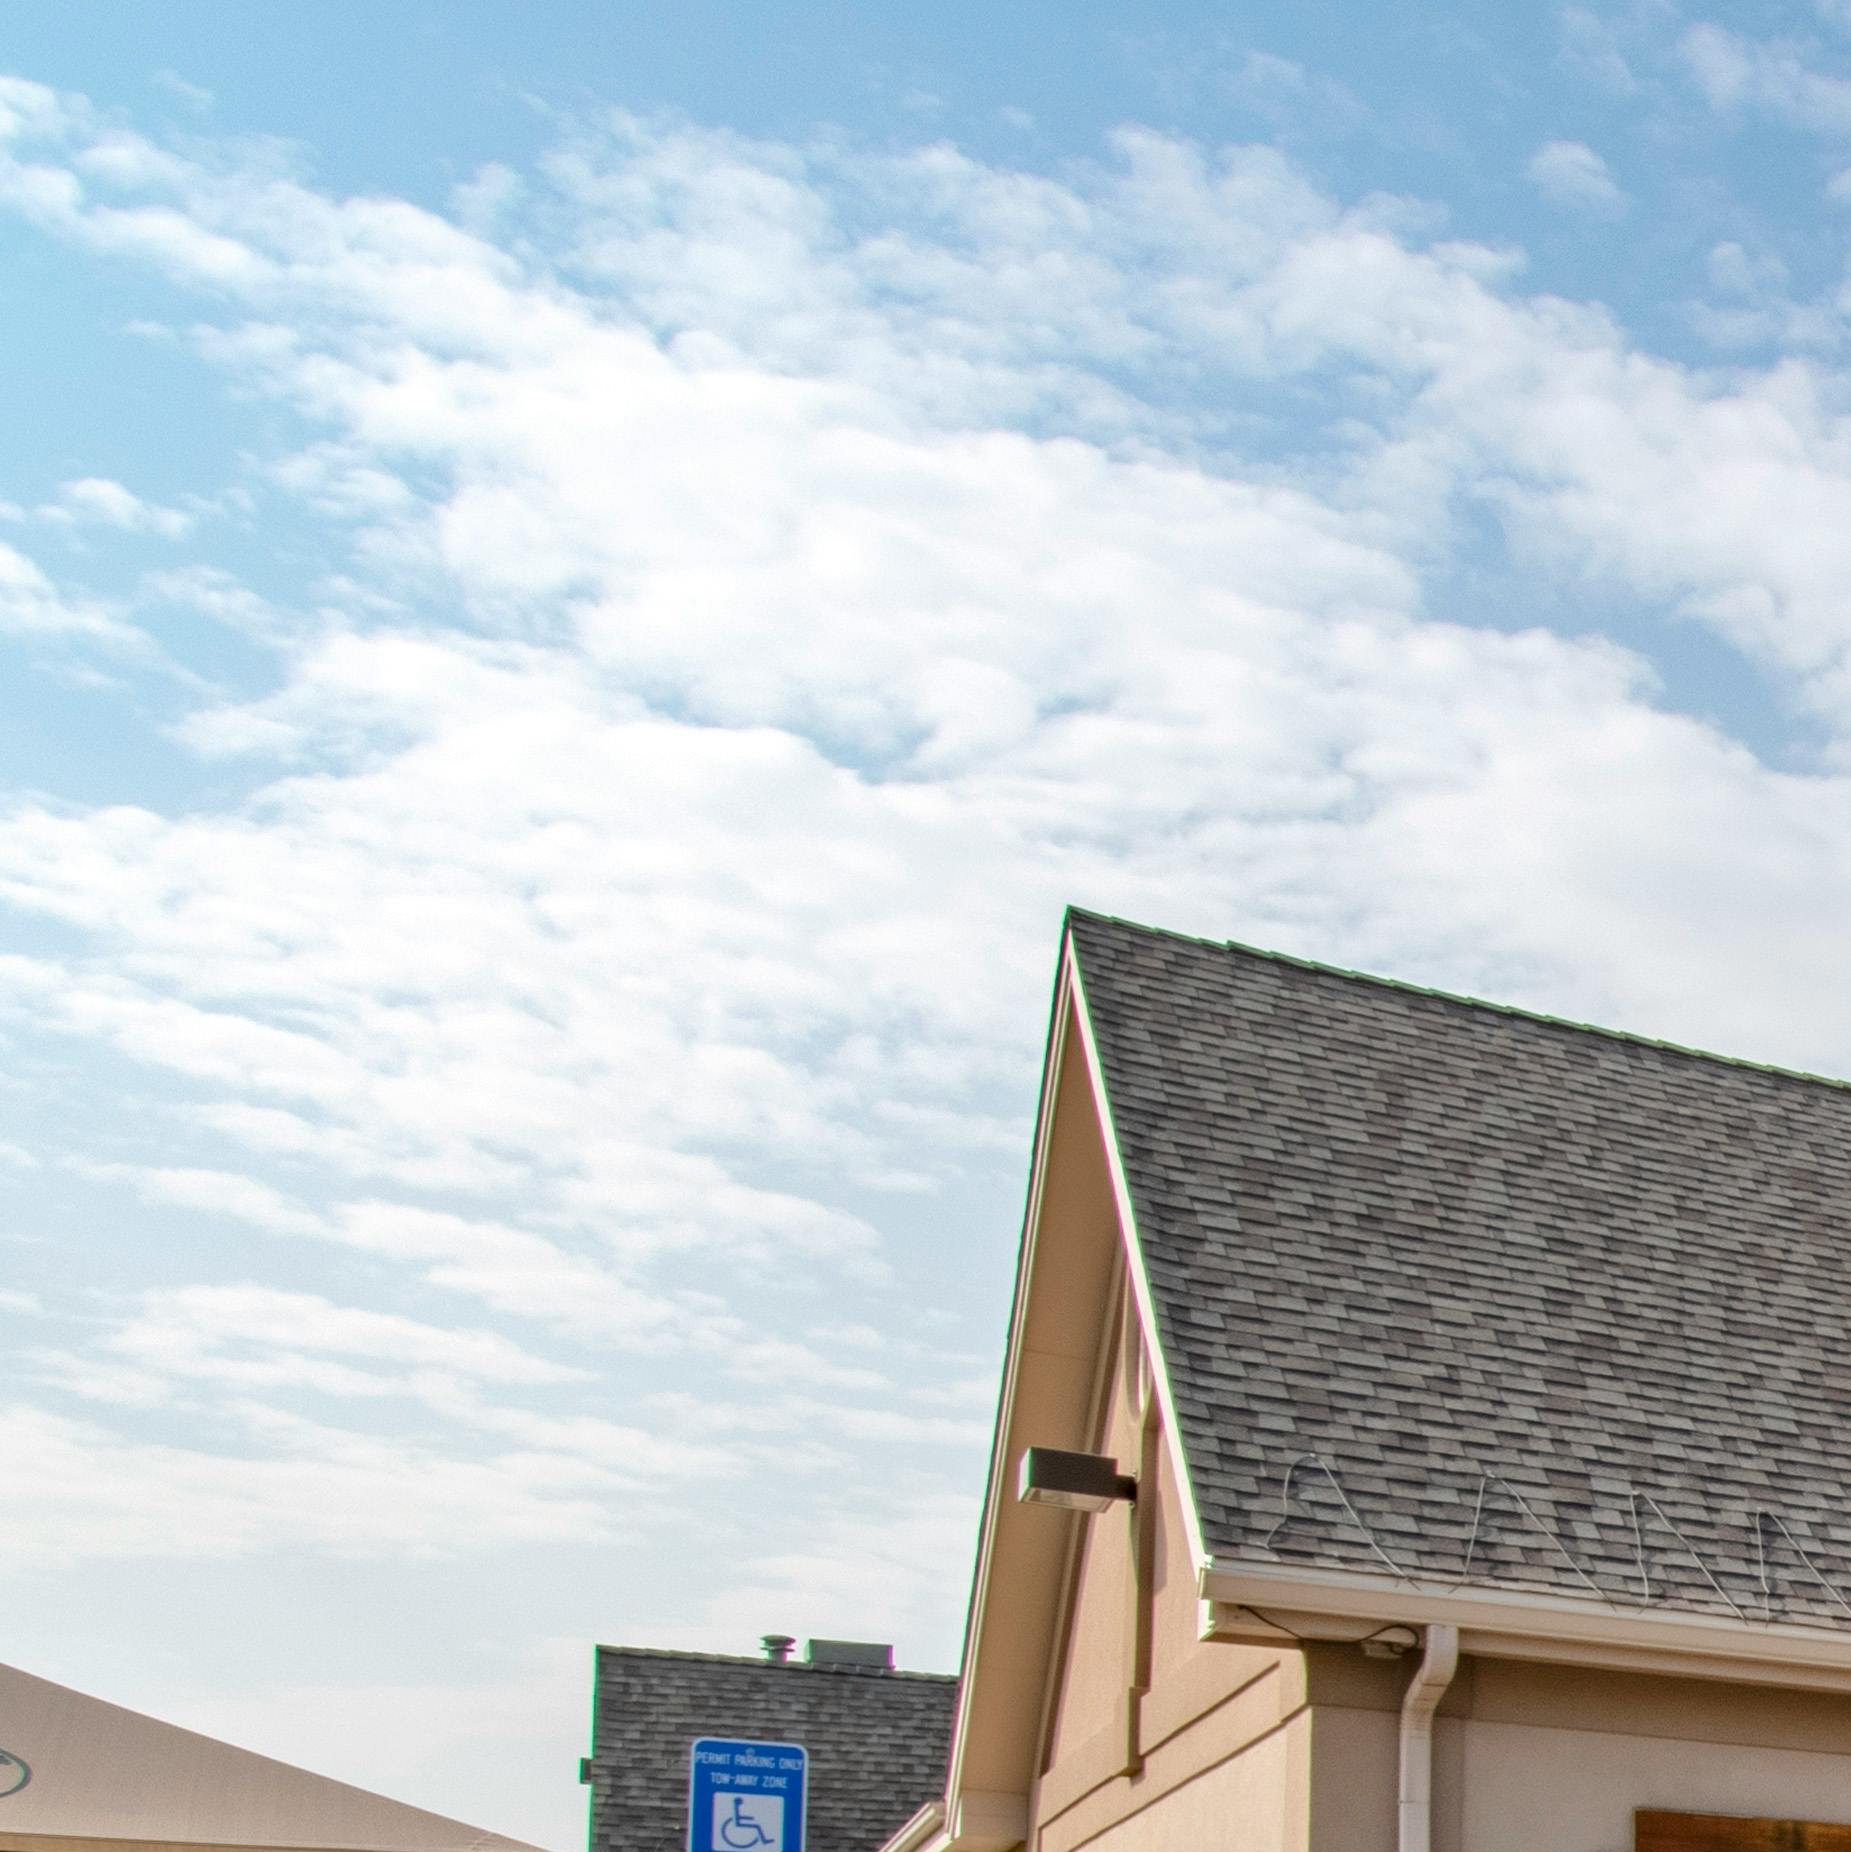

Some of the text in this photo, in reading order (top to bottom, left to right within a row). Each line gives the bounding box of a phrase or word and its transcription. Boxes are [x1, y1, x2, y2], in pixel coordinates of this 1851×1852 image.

[696, 1751, 803, 1771] PERMIT PARKING ONLY
[710, 1771, 788, 1789] TOW-AWAY ZONE
